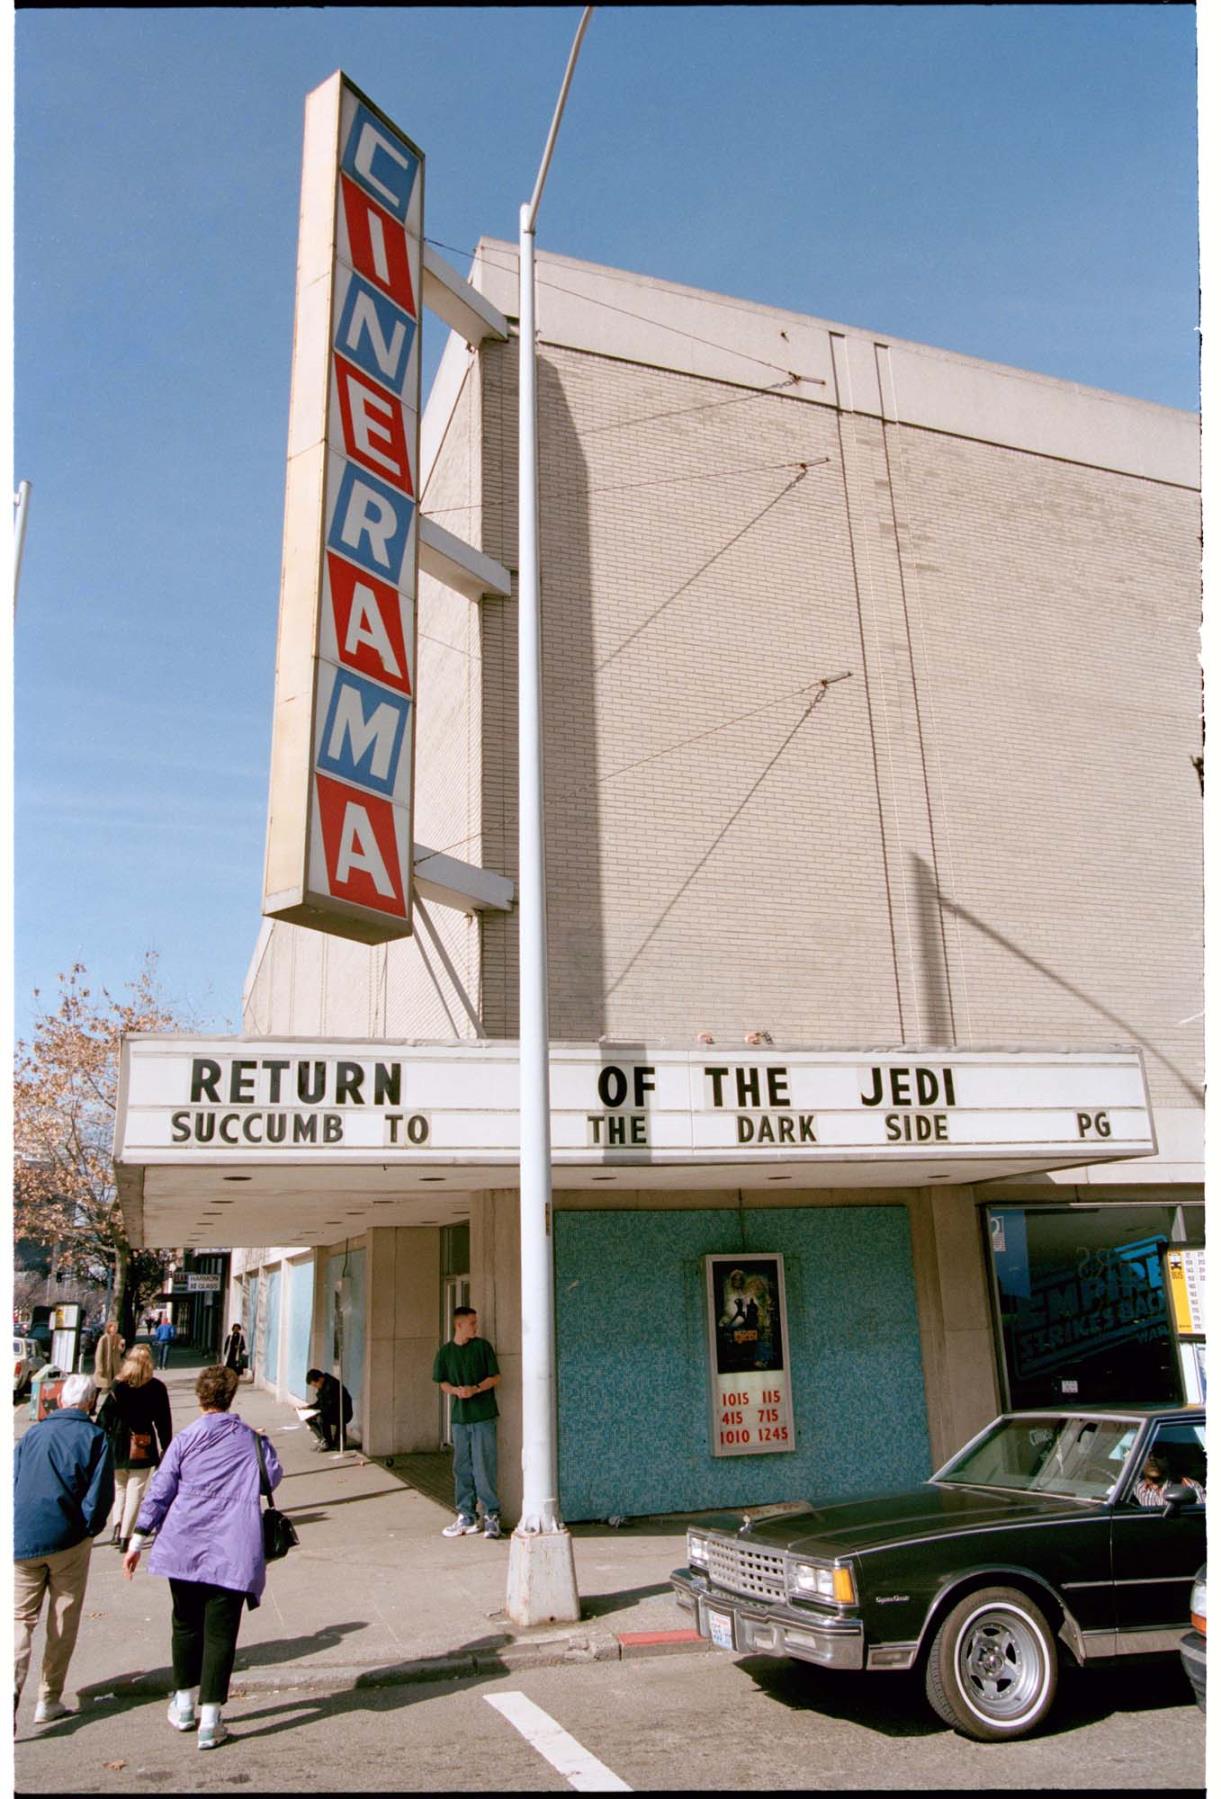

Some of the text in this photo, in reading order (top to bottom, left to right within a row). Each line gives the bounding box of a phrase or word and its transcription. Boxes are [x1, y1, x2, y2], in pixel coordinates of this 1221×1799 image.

[327, 120, 409, 901] CINERAMA
[190, 1058, 956, 1108] RETURN OF THE JEDI
[171, 1111, 949, 1146] SUCCUMB TO THE DARK SIDE
[1077, 1111, 1111, 1138] PG
[722, 1390, 781, 1406] 1015 115
[722, 1409, 779, 1425] 415 715
[720, 1427, 788, 1444] 1010 1245
